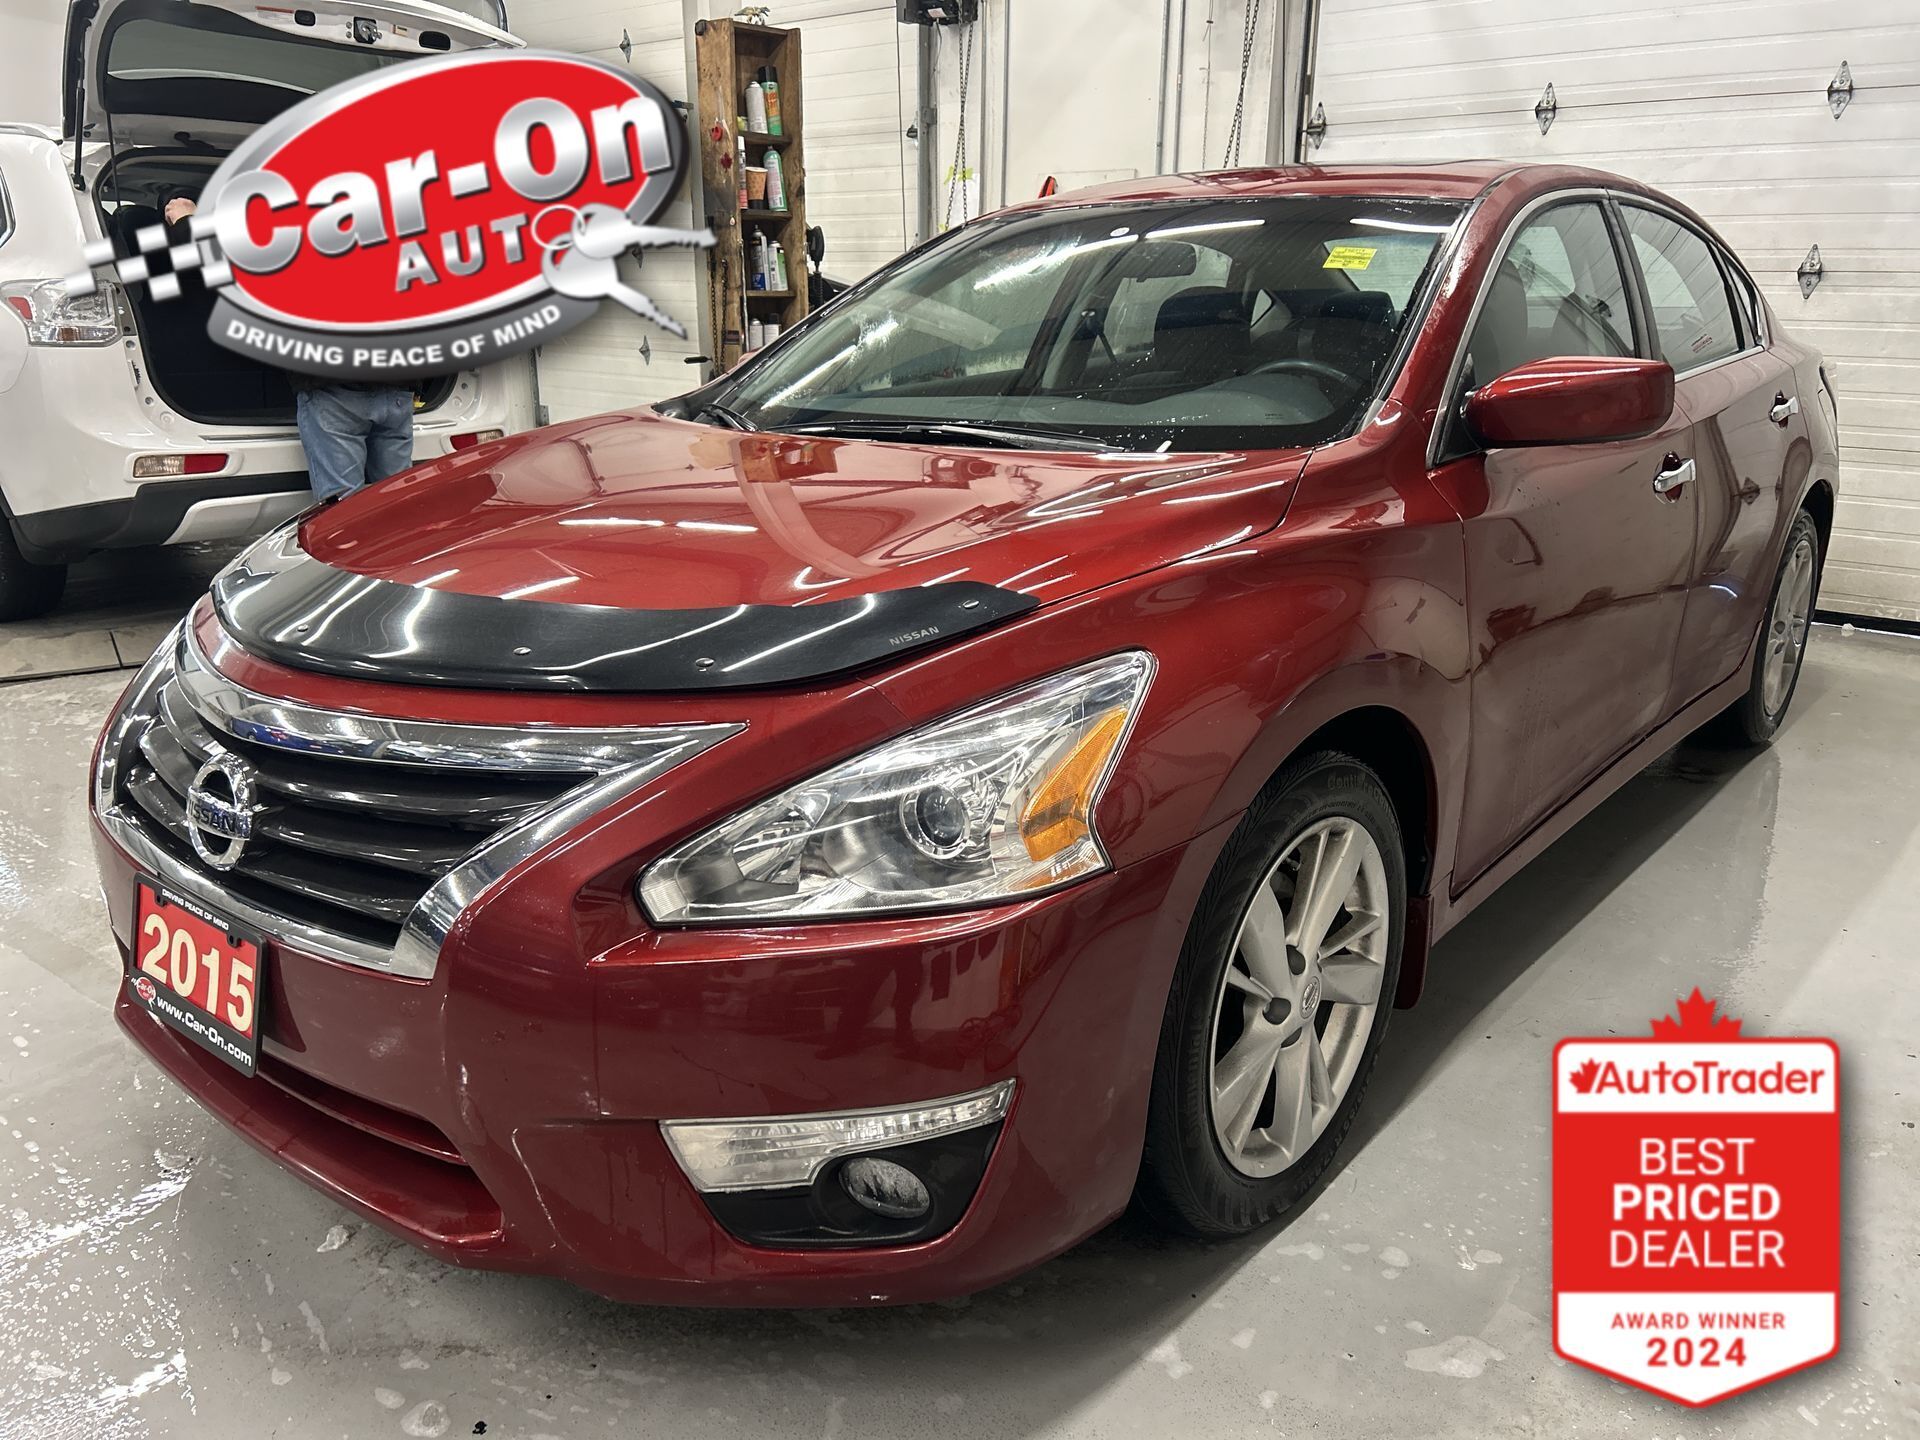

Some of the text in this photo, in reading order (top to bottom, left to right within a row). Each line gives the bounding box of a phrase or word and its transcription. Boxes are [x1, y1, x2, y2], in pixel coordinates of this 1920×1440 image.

[889, 626, 940, 646] NISSAN
[142, 914, 253, 1031] 2015
[157, 996, 252, 1067] www.Car-On.com
